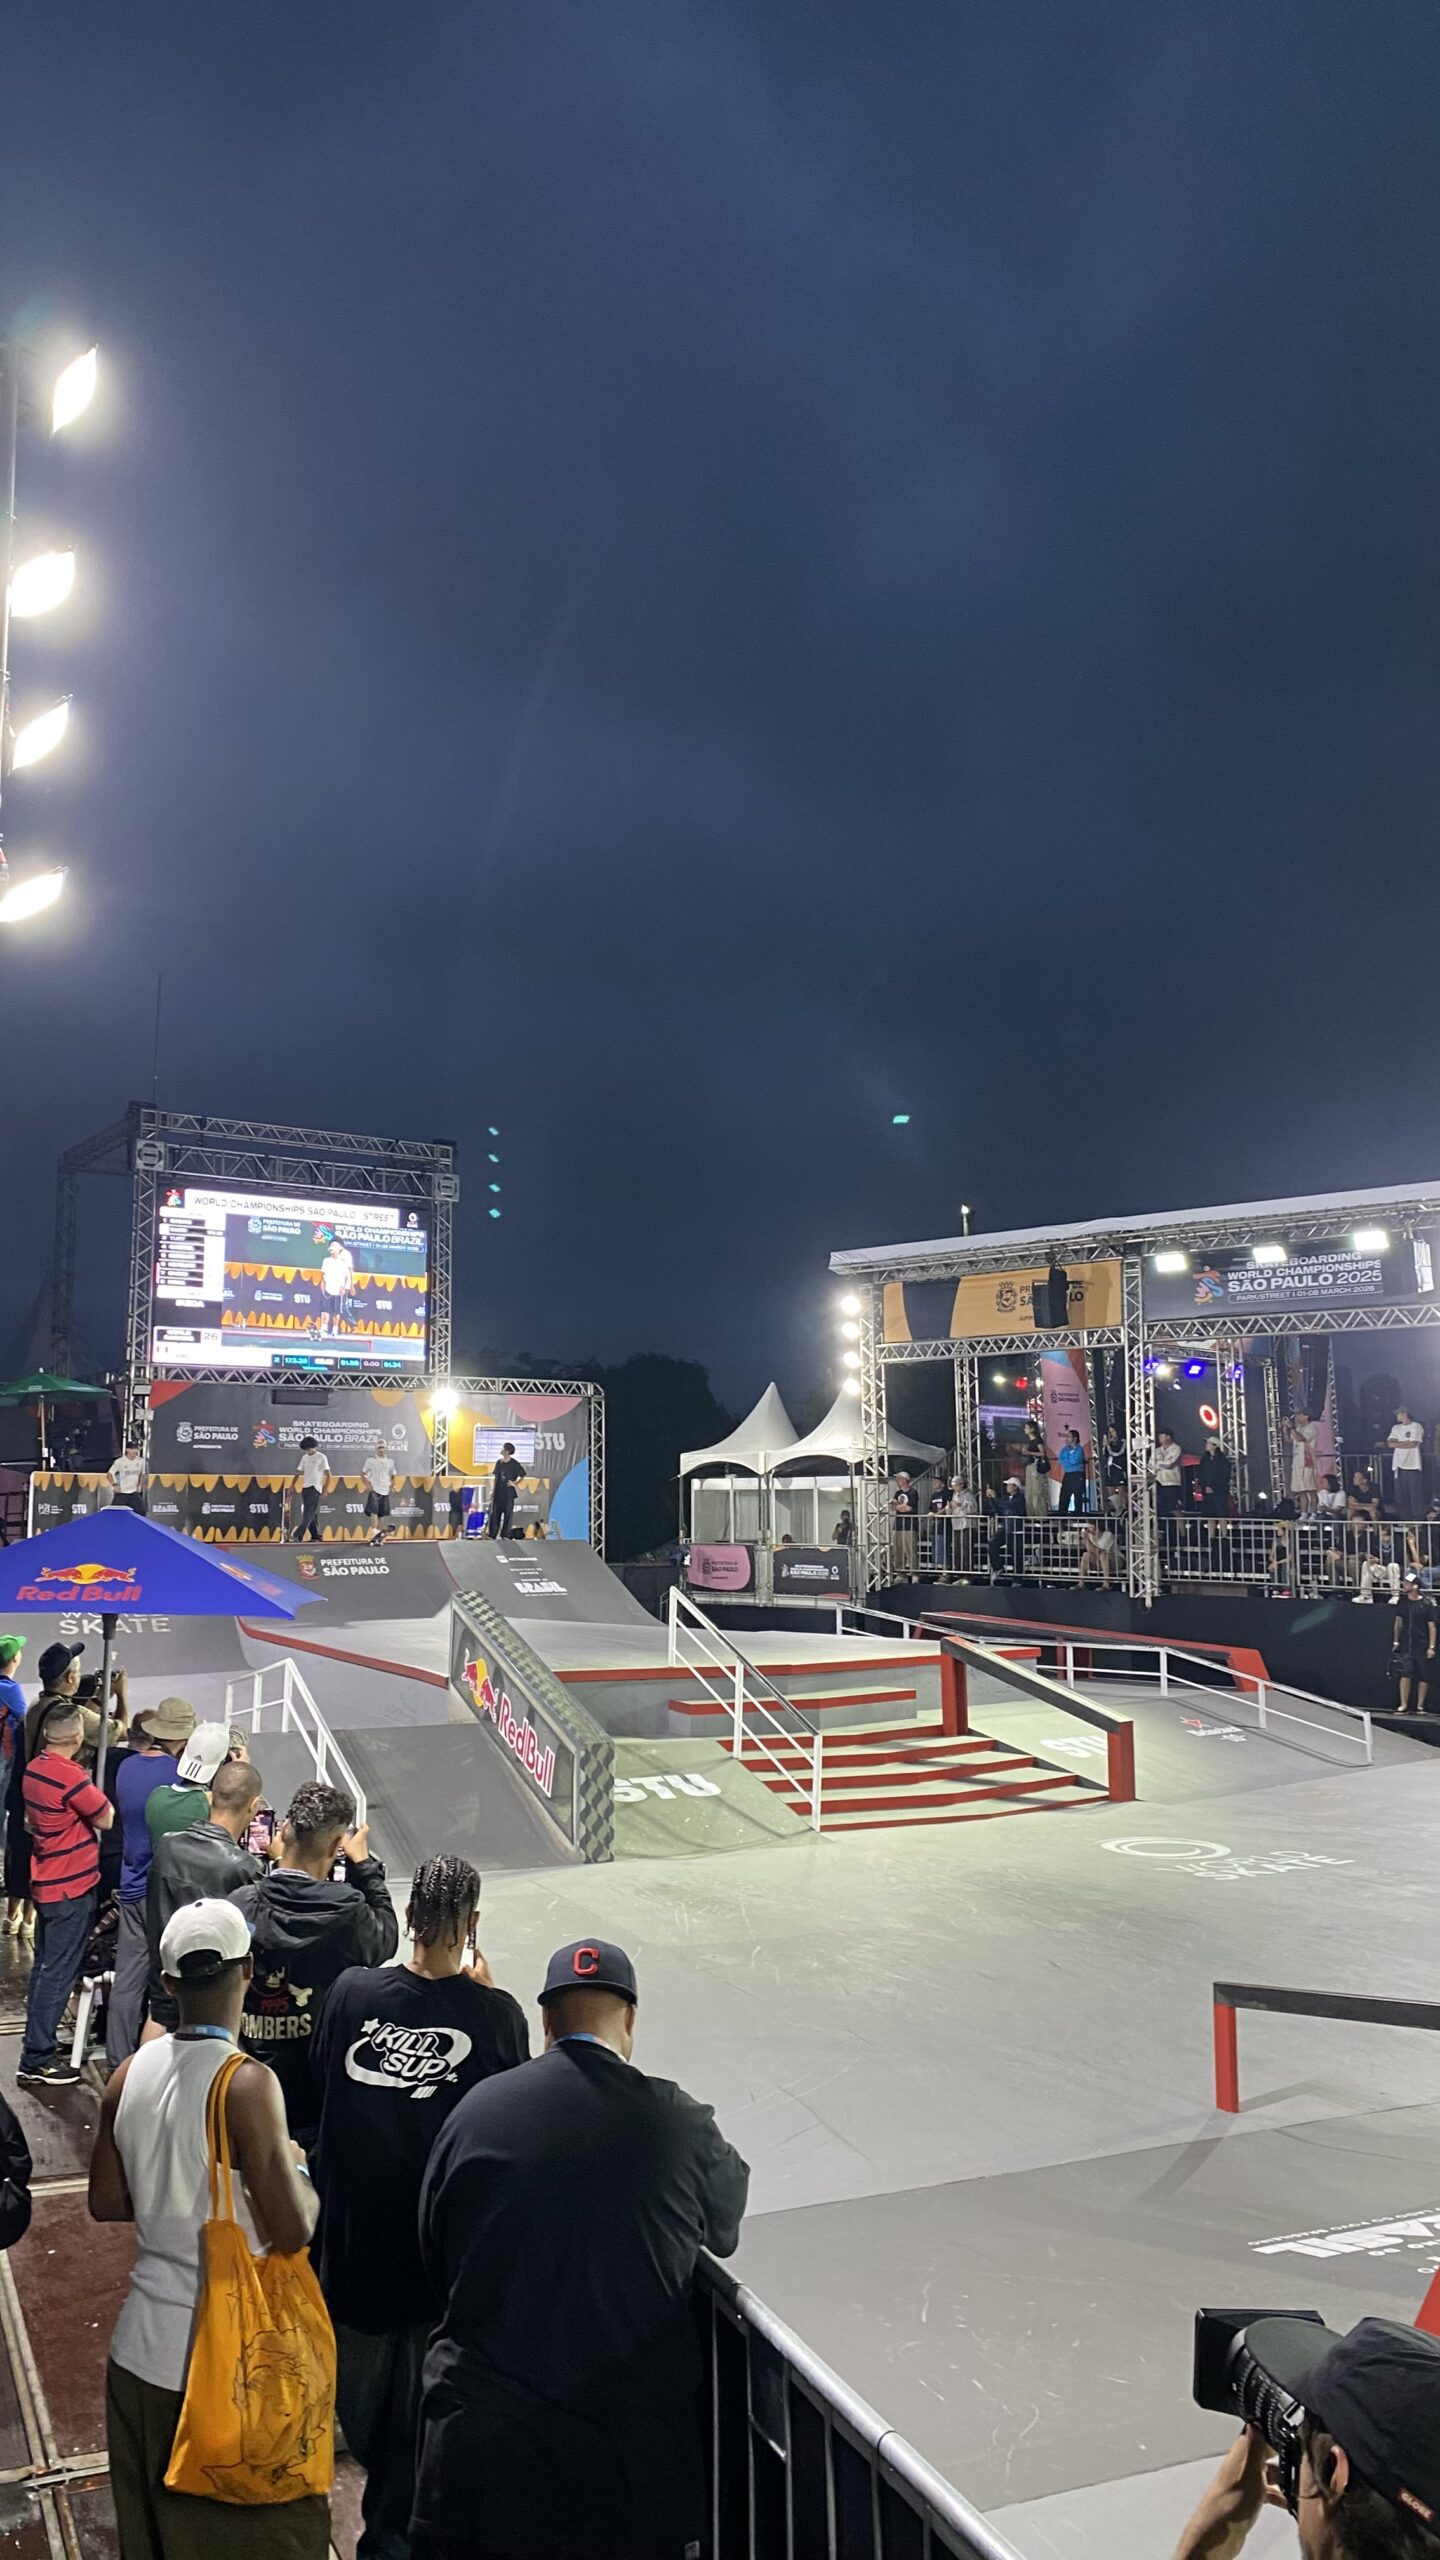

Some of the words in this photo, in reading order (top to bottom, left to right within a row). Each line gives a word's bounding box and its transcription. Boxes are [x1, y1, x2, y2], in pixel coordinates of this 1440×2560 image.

[194, 1197, 227, 1207] WORLD
[230, 1199, 305, 1214] CHAMPIONSHIPS
[328, 1209, 355, 1219] PAULO
[363, 1212, 395, 1222] STREET
[335, 1224, 363, 1233] WORLD
[358, 1232, 391, 1244] PAULO
[391, 1235, 424, 1246] BRAZIL
[1227, 1269, 1273, 1280] WORLD
[1275, 1259, 1381, 1277] CHAMPIONSHIPS
[1228, 1279, 1267, 1292] SÃO
[1270, 1273, 1333, 1289] PAULO
[1336, 1269, 1382, 1285] 2025
[294, 1293, 311, 1304] STU
[1236, 1291, 1291, 1301] PARK/STREET
[1320, 1286, 1352, 1295] MARCH
[204, 1332, 218, 1340] 26
[193, 1425, 230, 1433] PREFEITURA
[292, 1420, 369, 1428] SKATEBOARDING
[312, 1427, 382, 1435] CHAMPIONSHIPS
[193, 1431, 211, 1440] SÃO
[211, 1432, 239, 1441] PAULO
[279, 1432, 305, 1442] SÃO
[535, 1432, 566, 1451] STU
[71, 1504, 87, 1514] STU
[249, 1503, 269, 1514] STU
[345, 1503, 364, 1513] STU
[434, 1502, 452, 1512] STU
[320, 1558, 374, 1567] PREFEITURA
[375, 1557, 387, 1565] DE
[323, 1565, 350, 1577] SÃO
[350, 1565, 390, 1576] PAULO
[16, 1585, 81, 1601] Red
[82, 1585, 143, 1602] Bull
[58, 1617, 172, 1635] SKATE
[613, 1773, 722, 1803] STU
[1153, 1850, 1310, 1873] WORLD
[1193, 1854, 1356, 1881] SKATE
[573, 1947, 600, 1975] C
[241, 2011, 312, 2040] OMBERS
[374, 2024, 436, 2057] KILL
[382, 2052, 448, 2079] SUP
[1251, 2212, 1440, 2259] ASIL
